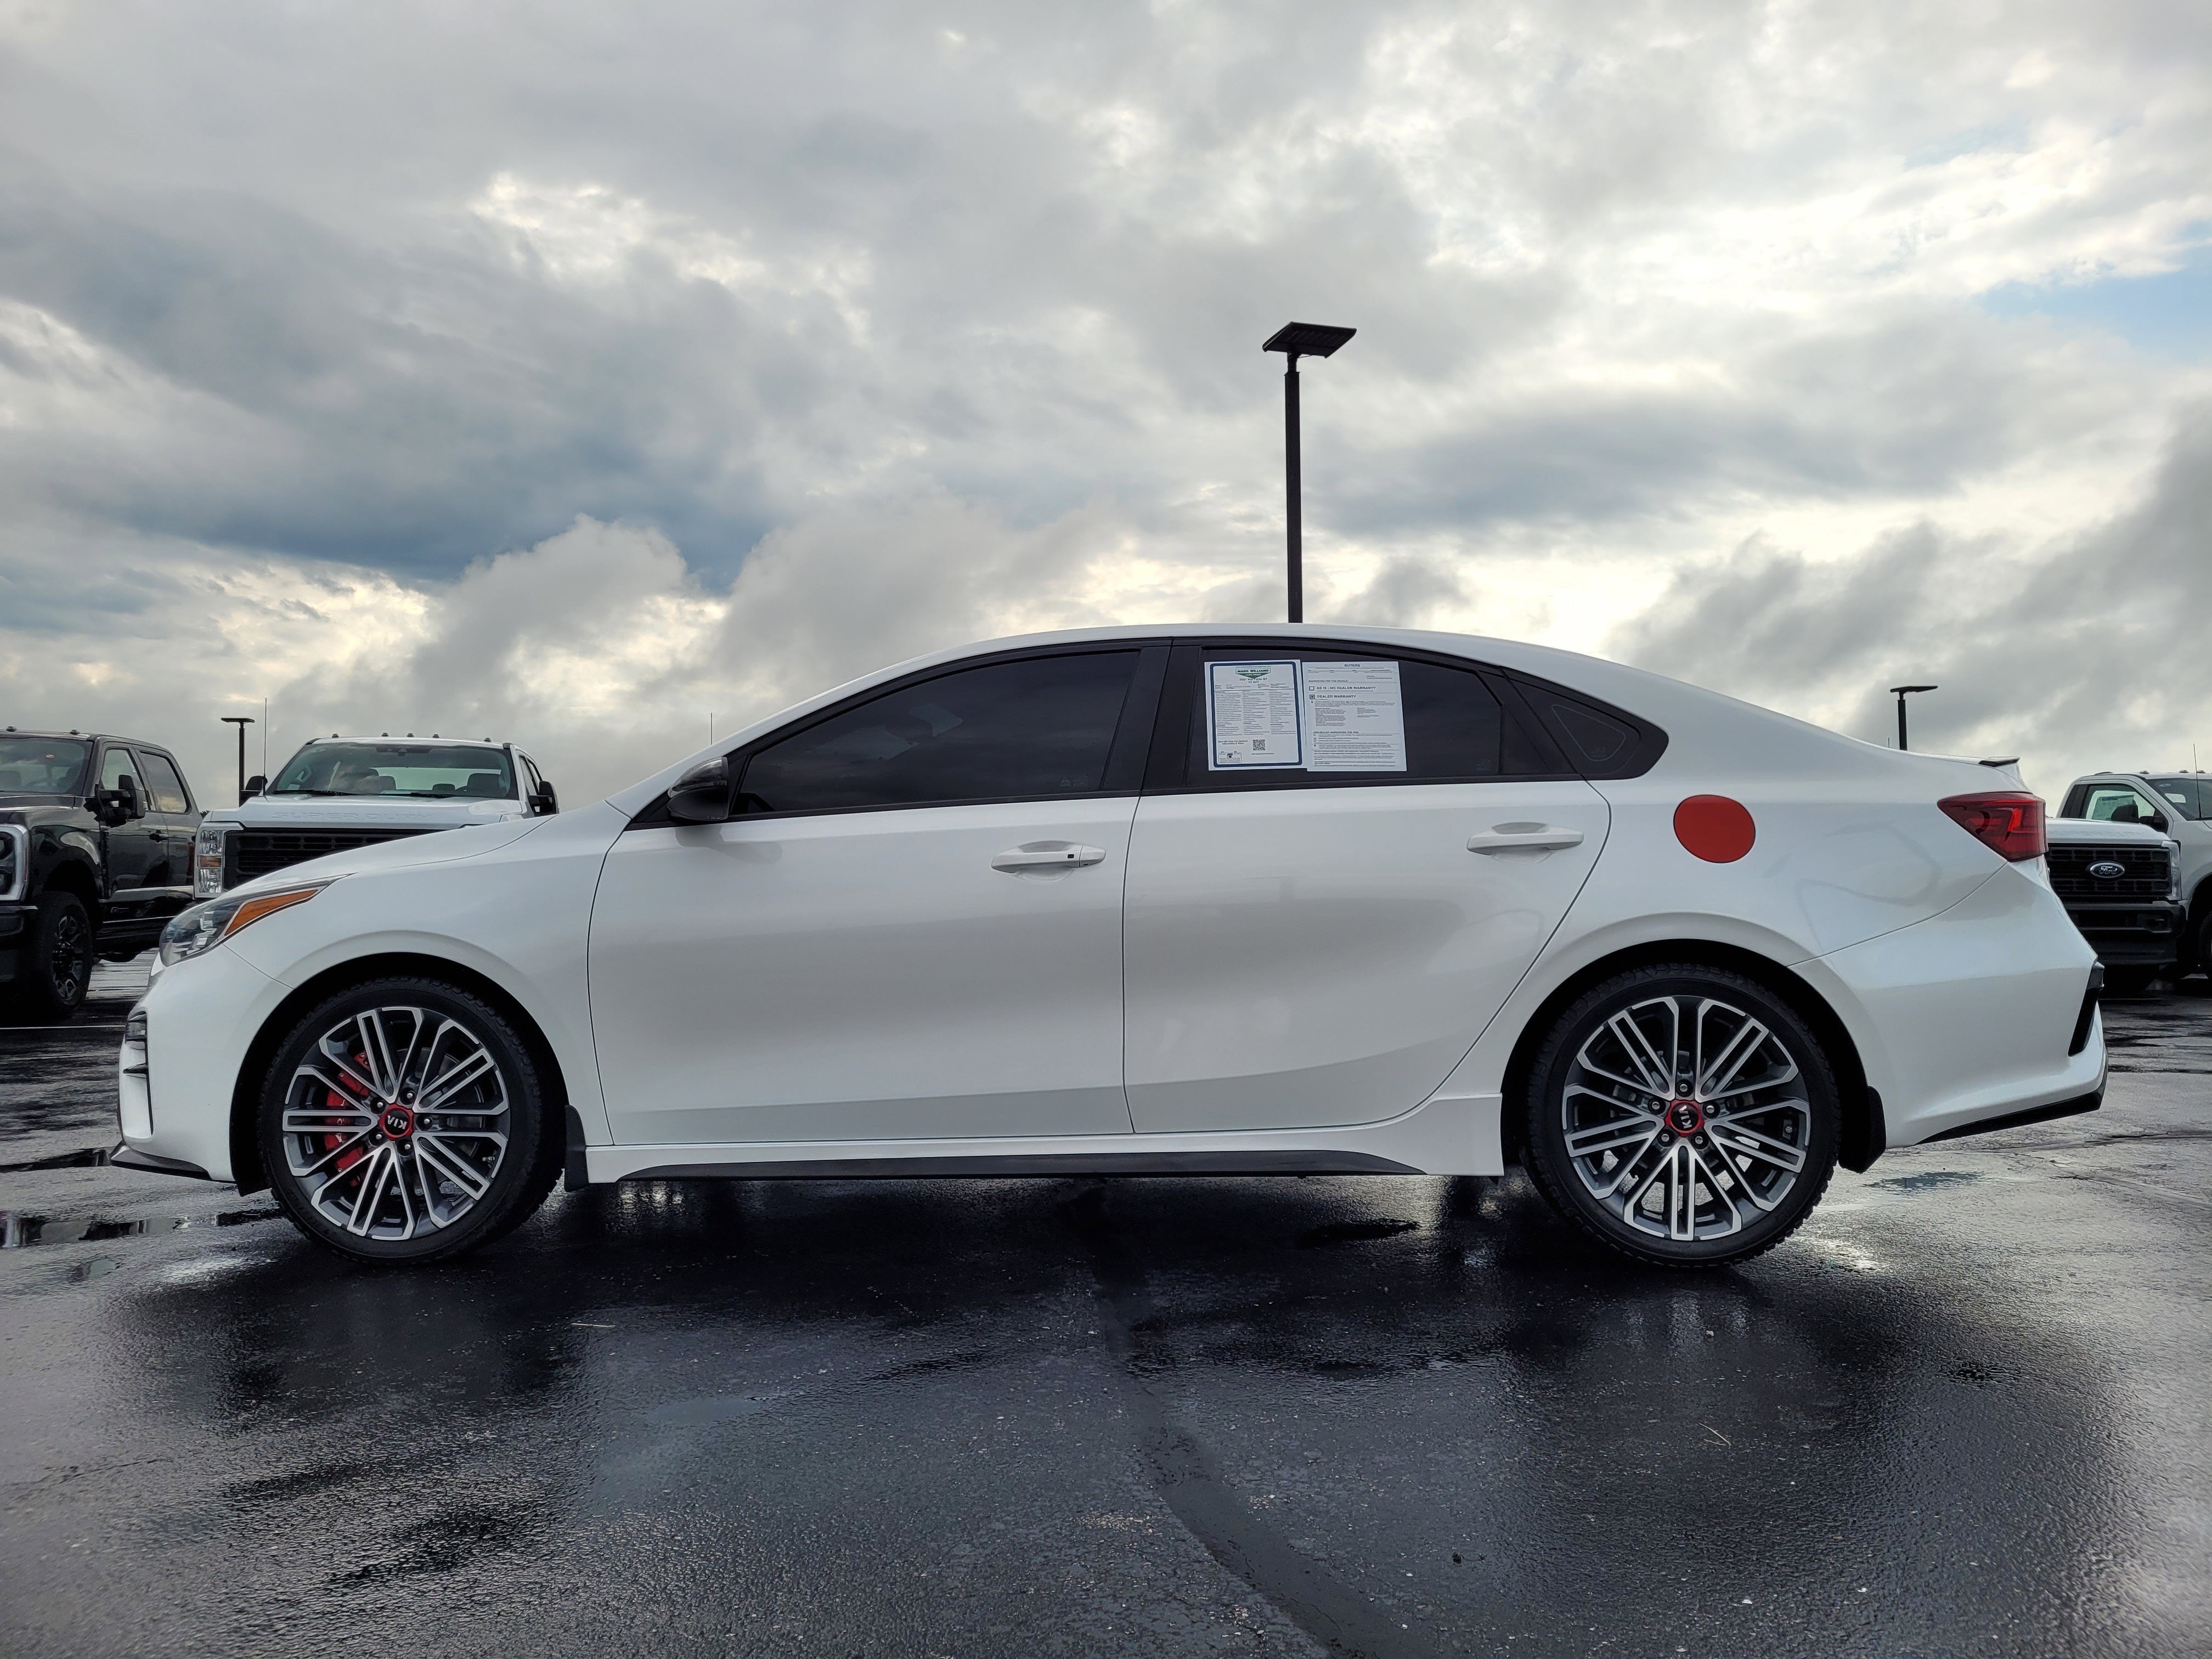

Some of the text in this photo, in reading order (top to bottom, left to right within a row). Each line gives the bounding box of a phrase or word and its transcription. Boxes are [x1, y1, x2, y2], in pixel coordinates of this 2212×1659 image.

[2099, 866, 2118, 874] Ford
[387, 1115, 408, 1130] KIA
[1679, 1105, 1692, 1129] KIA
